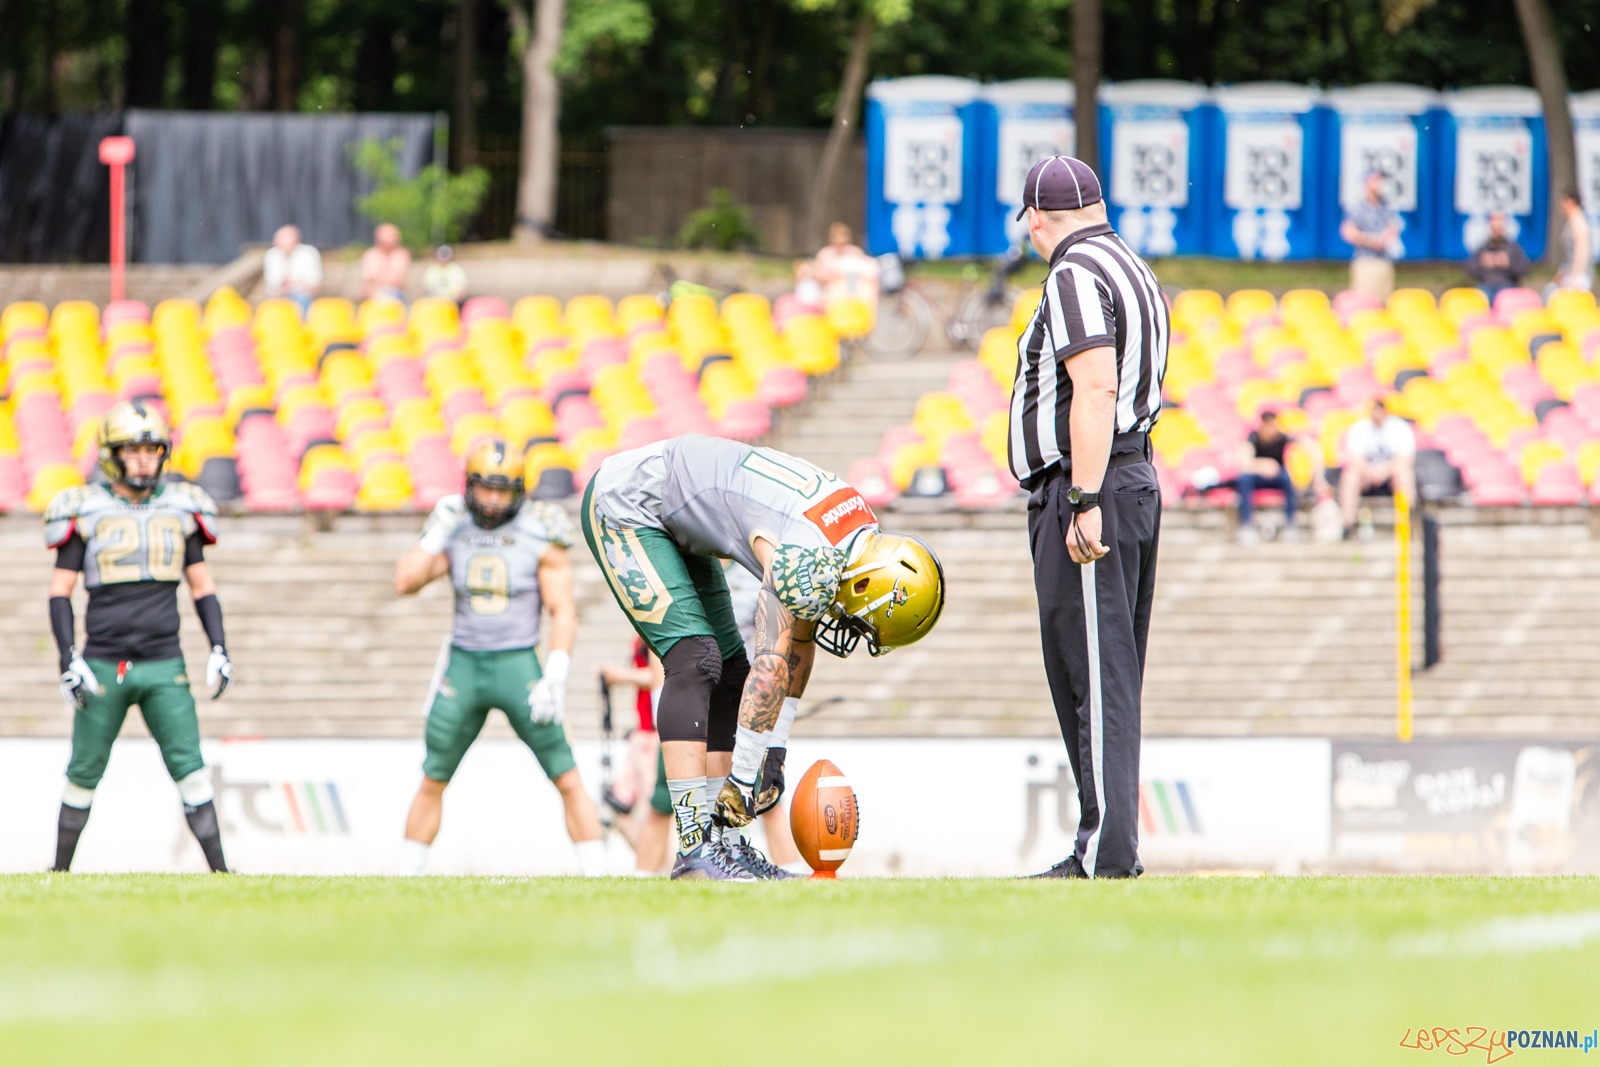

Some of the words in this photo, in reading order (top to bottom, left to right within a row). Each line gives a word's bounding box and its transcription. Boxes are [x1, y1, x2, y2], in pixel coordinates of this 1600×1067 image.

[820, 495, 865, 527] Santander
[95, 515, 185, 584] 20
[466, 553, 509, 615] 9
[826, 806, 836, 835] GST
[842, 796, 852, 840] Wilson
[1018, 755, 1080, 860] jt
